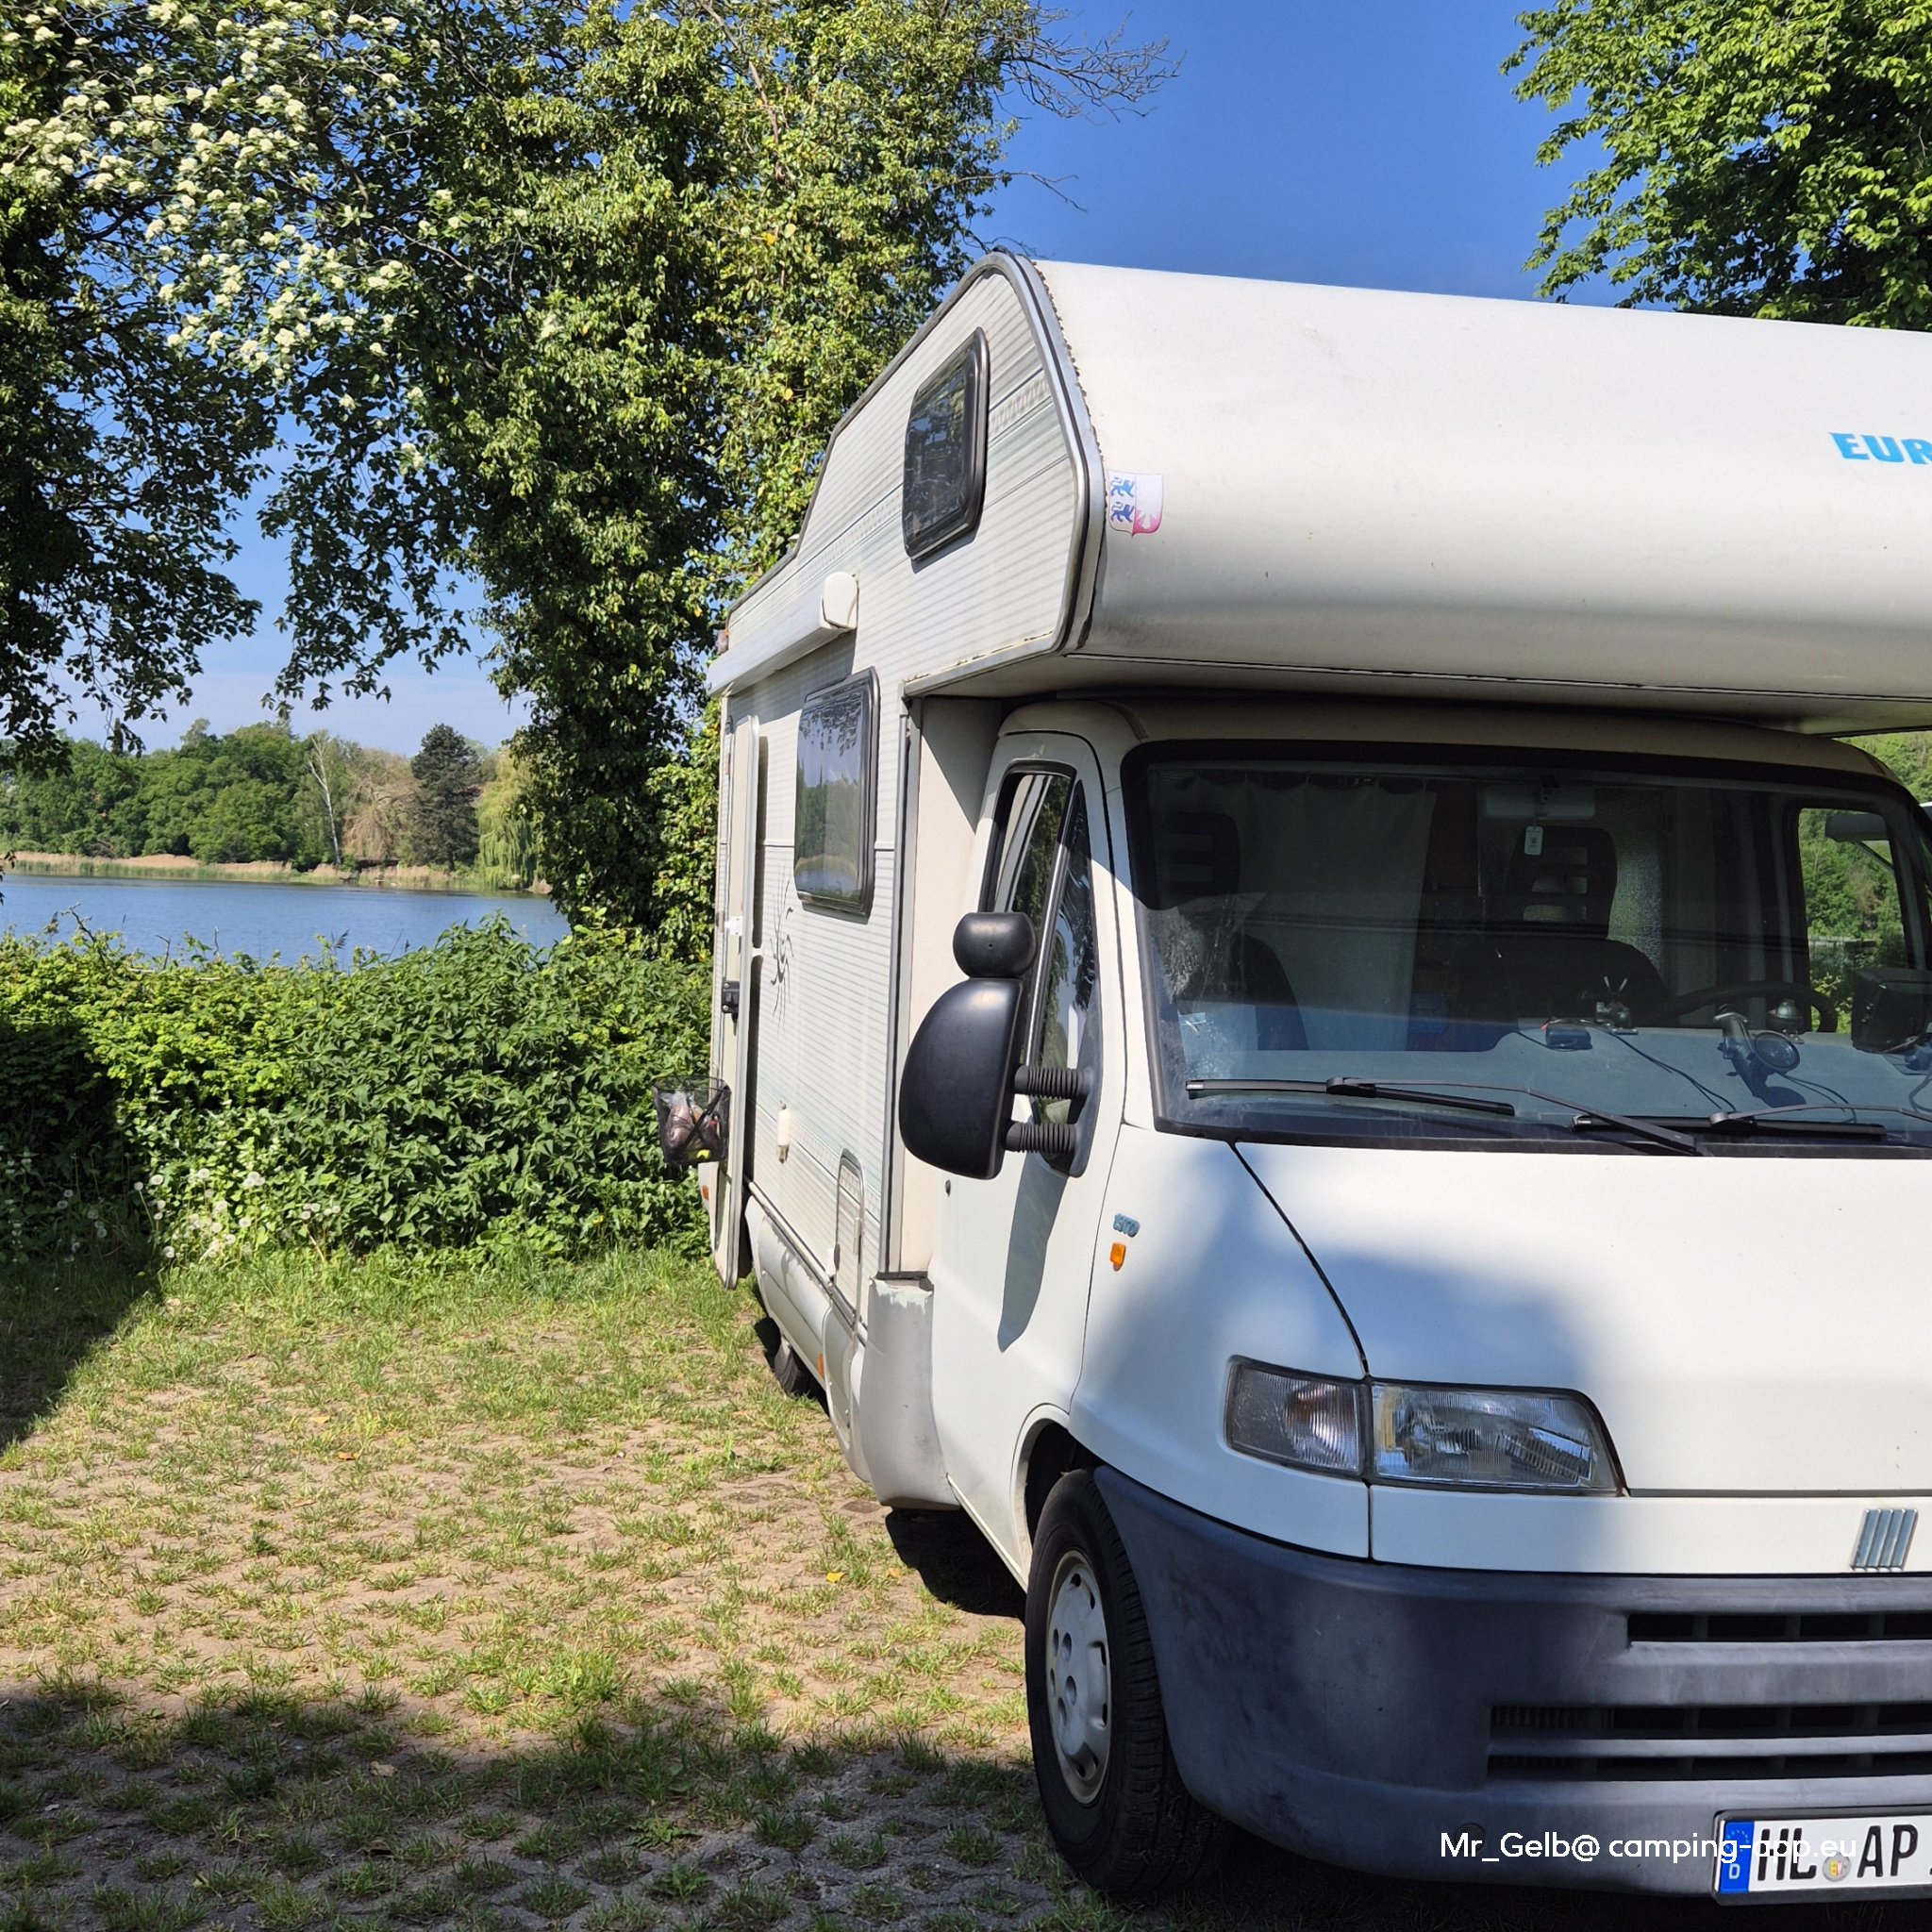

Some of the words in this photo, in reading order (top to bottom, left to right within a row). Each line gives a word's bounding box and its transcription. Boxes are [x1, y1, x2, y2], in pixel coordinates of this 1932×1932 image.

[1757, 1827, 1817, 1881] HL
[1857, 1824, 1919, 1878] AP
[1728, 1863, 1740, 1879] D
